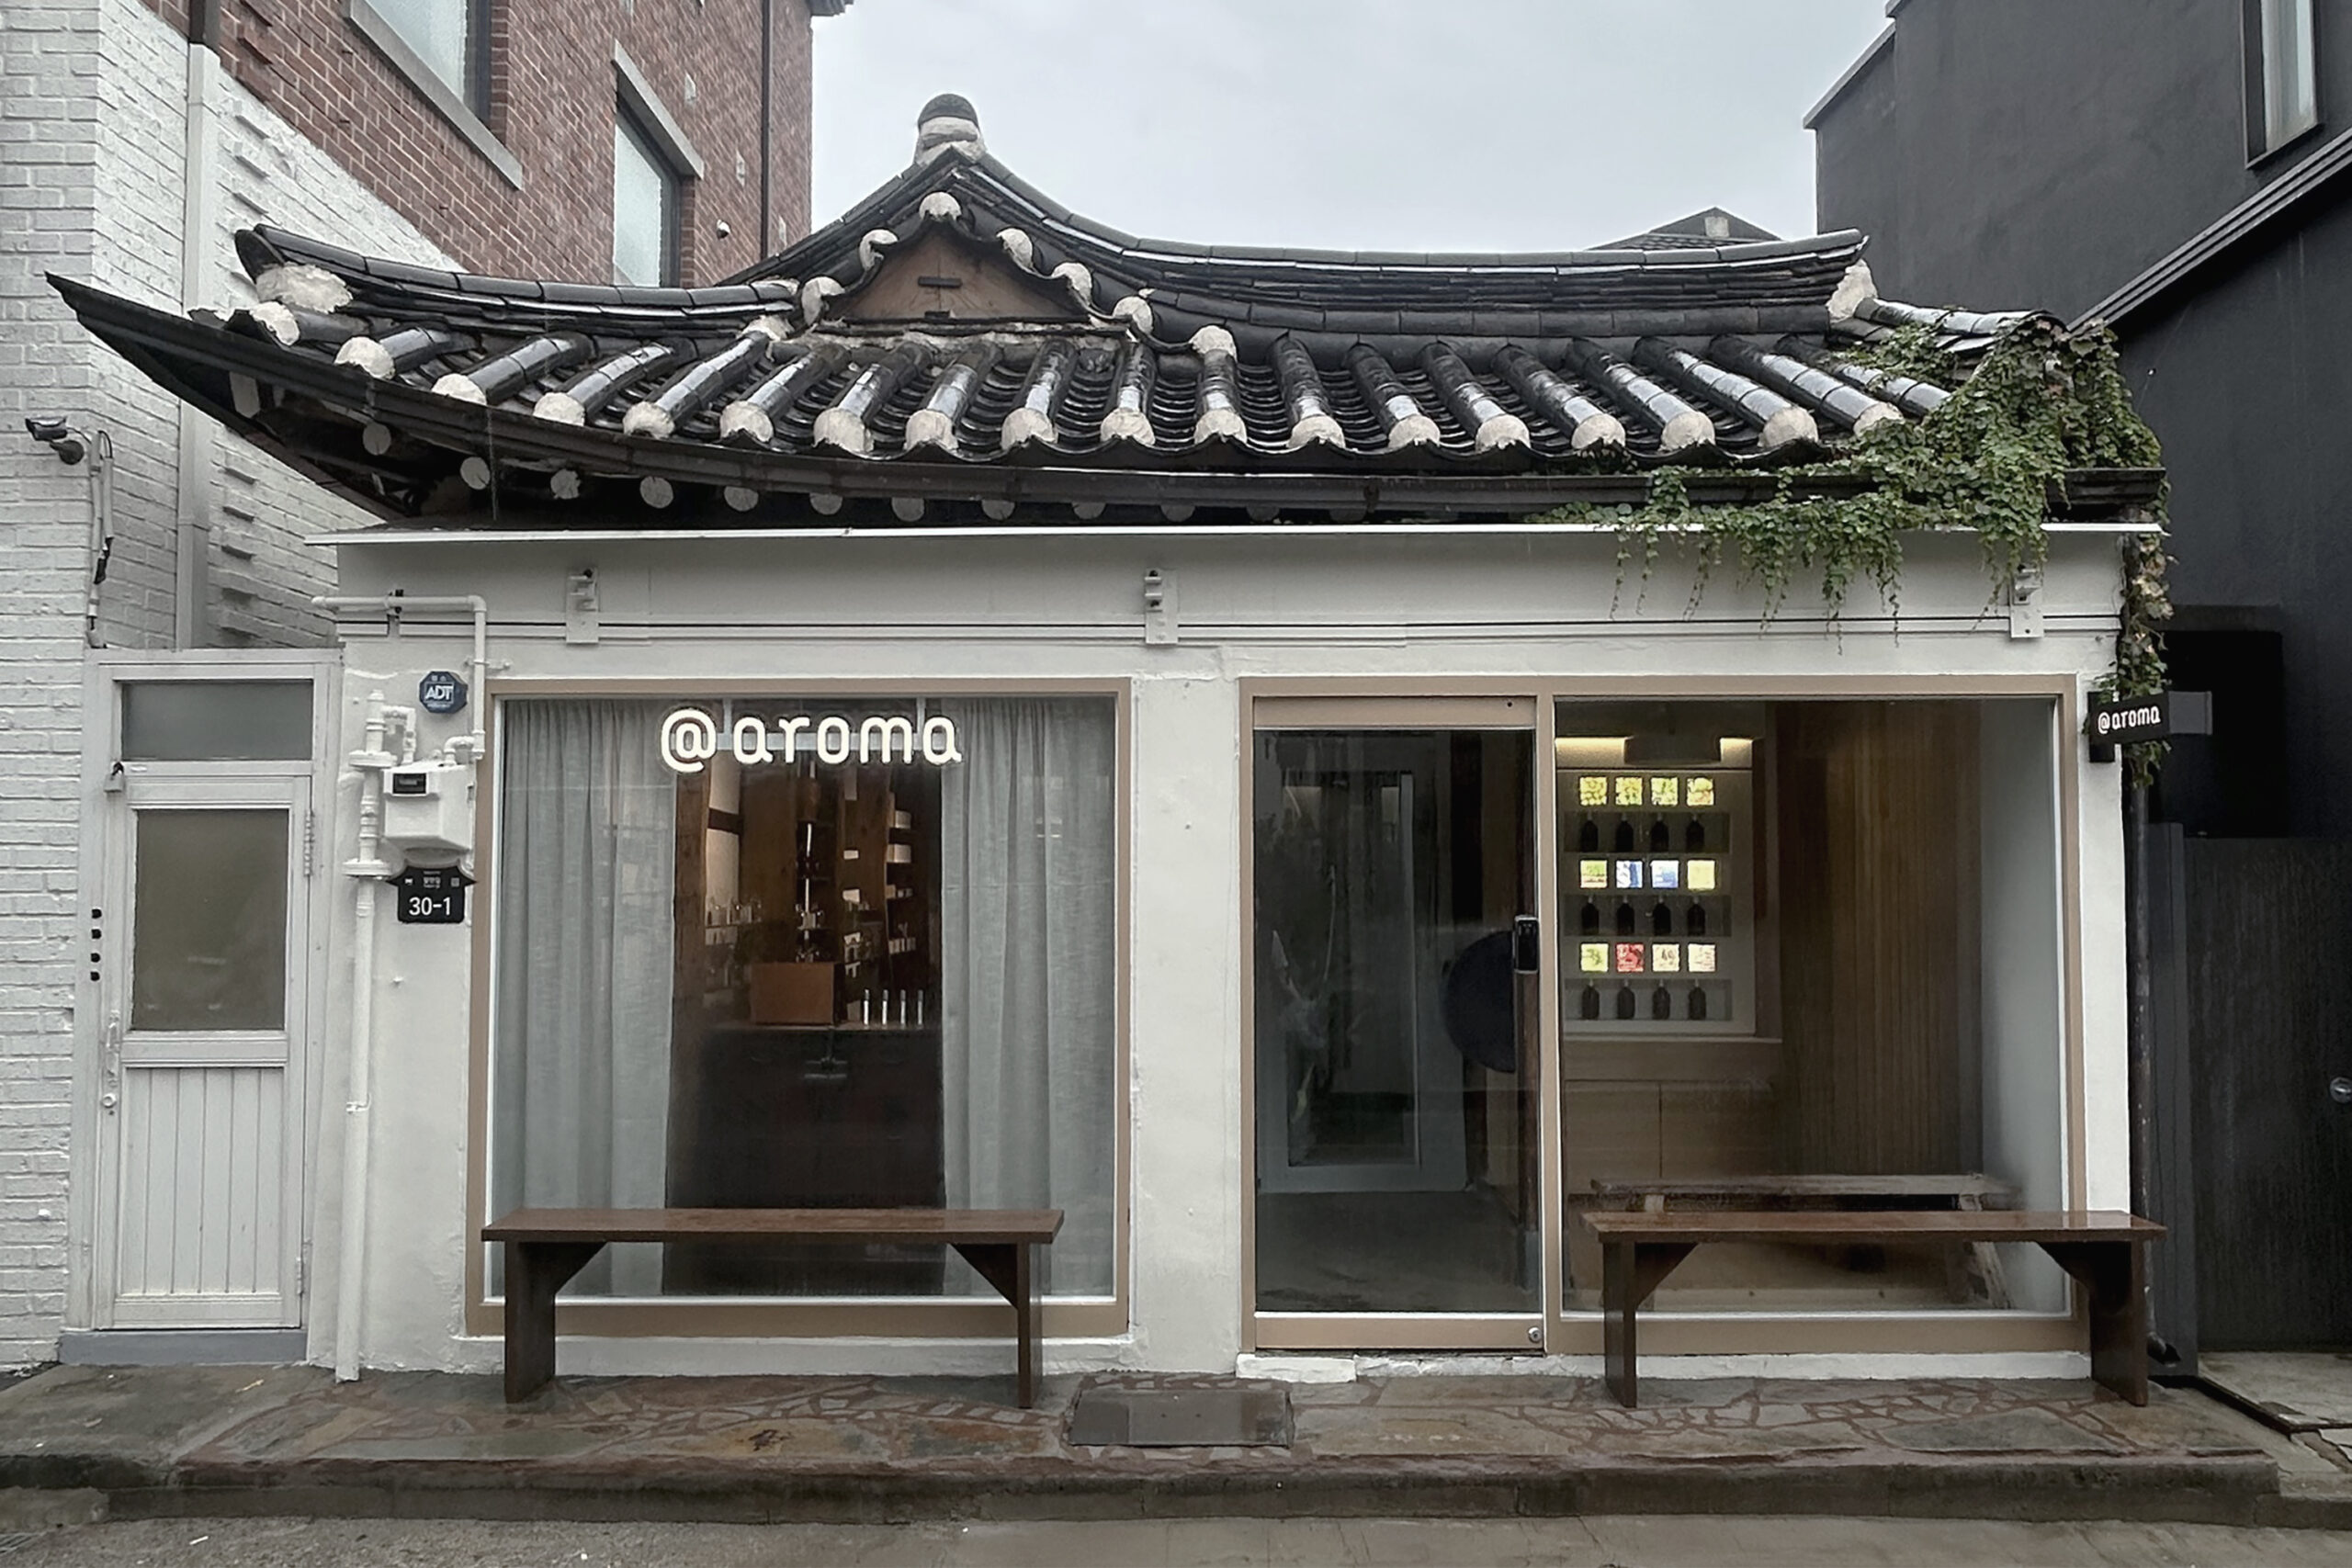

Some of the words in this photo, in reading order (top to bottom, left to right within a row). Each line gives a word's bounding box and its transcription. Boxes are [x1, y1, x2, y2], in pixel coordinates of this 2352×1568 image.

[425, 685, 454, 700] ADT
[2098, 705, 2161, 735] @aroma
[661, 708, 963, 773] @aroma
[409, 897, 451, 916] 30-1
